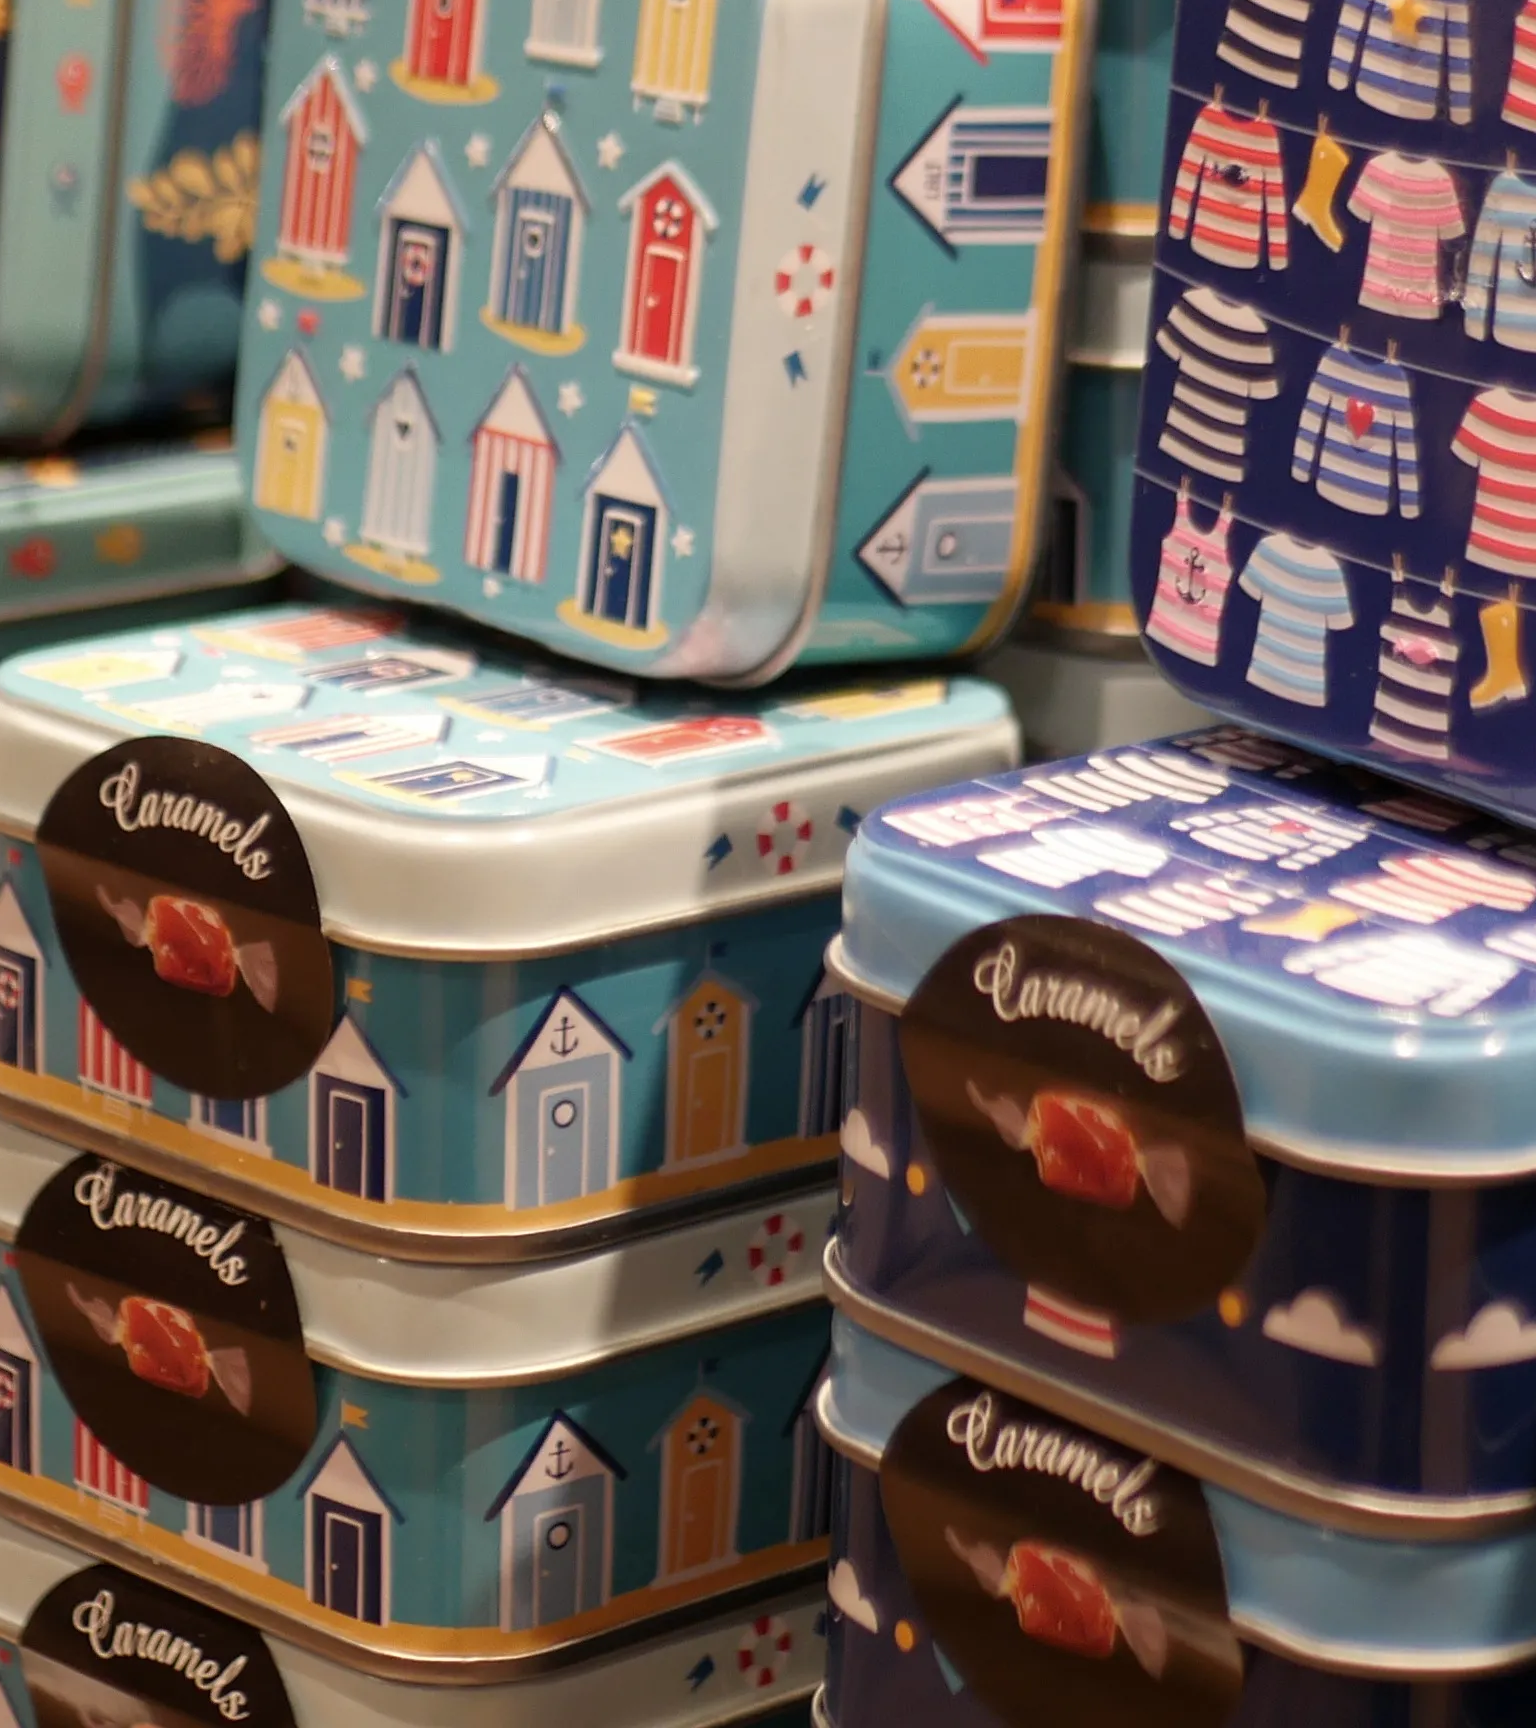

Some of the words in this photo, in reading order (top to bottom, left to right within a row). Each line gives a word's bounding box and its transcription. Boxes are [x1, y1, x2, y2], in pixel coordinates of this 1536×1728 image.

[99, 760, 275, 880] Caramels
[972, 940, 1185, 1083] Caramels
[74, 1161, 249, 1285] Caramels
[946, 1391, 1163, 1536] Caramels
[72, 1589, 250, 1721] Caramels
